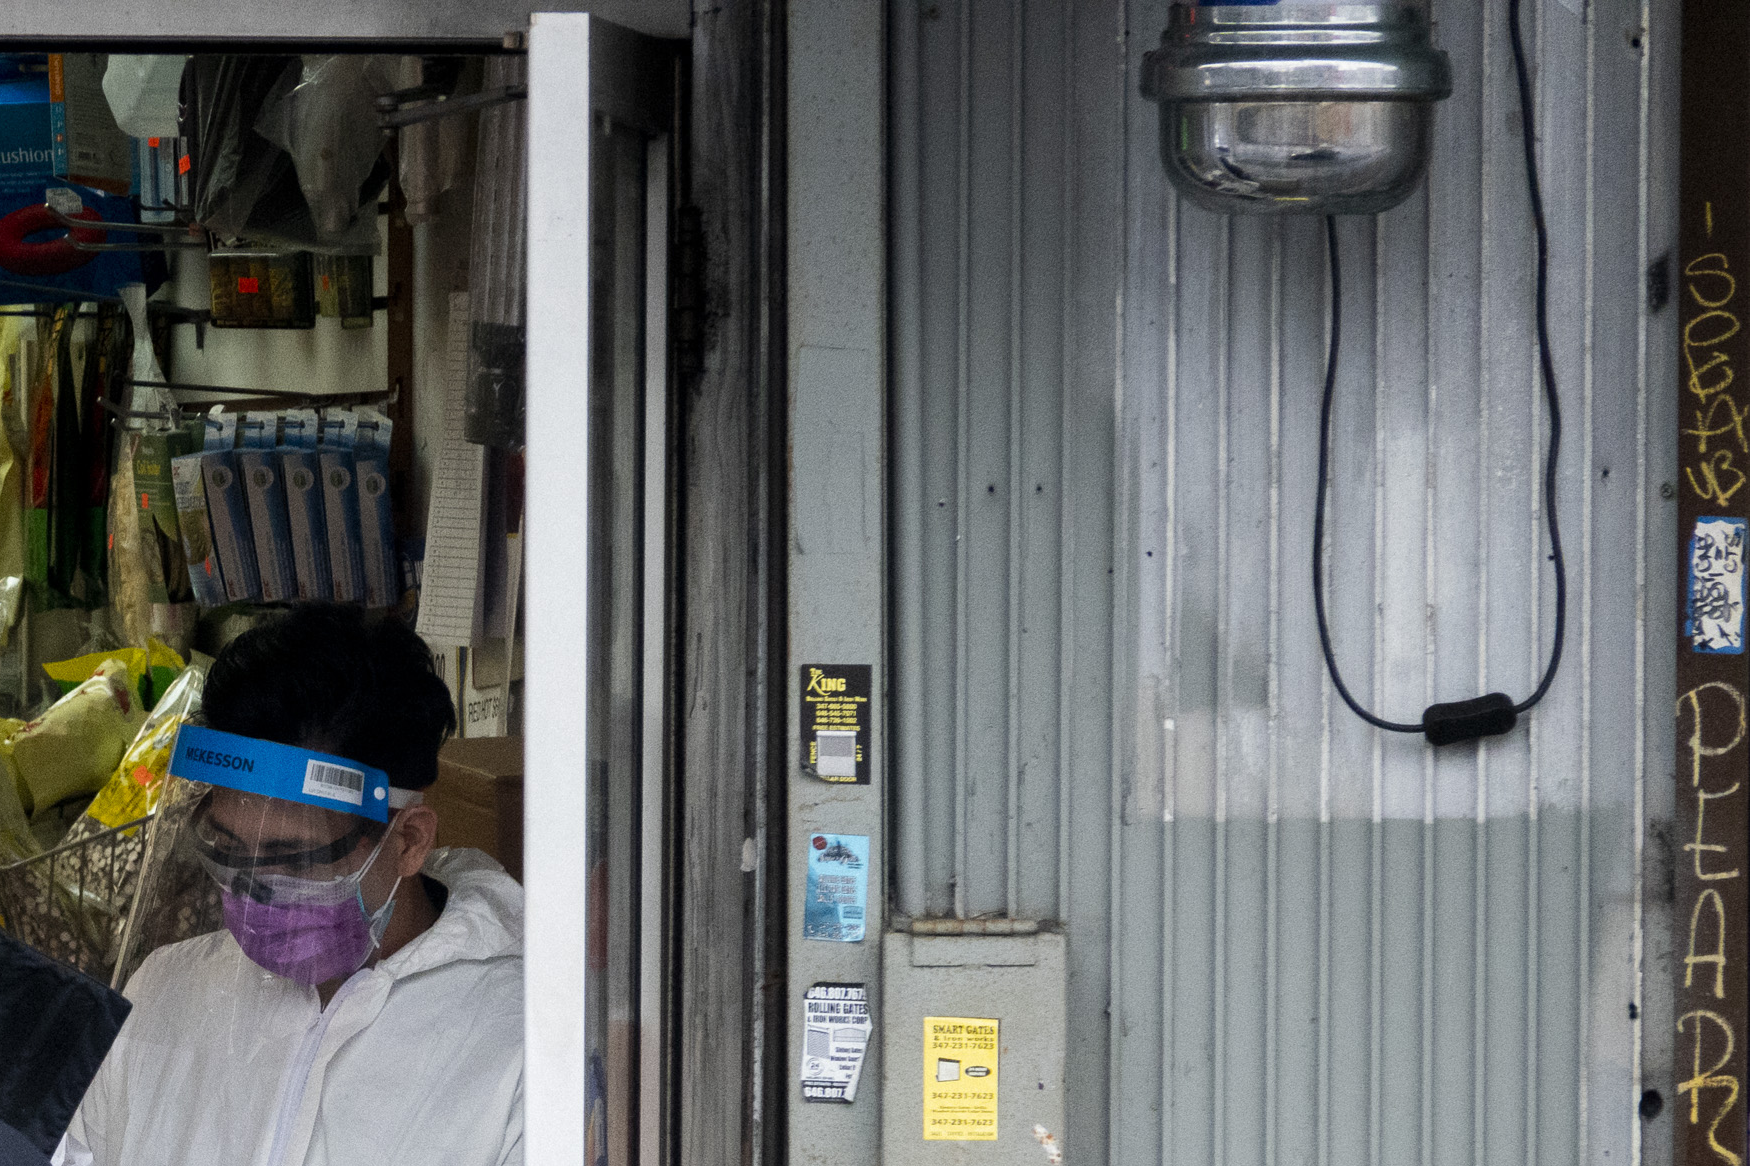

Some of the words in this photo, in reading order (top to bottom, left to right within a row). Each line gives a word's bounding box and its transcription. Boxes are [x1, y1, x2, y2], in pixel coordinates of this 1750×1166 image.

[808, 1002, 841, 1014] ROLLING
[843, 1003, 868, 1015] GATES
[933, 1025, 963, 1034] SMART
[966, 1026, 994, 1035] GATES
